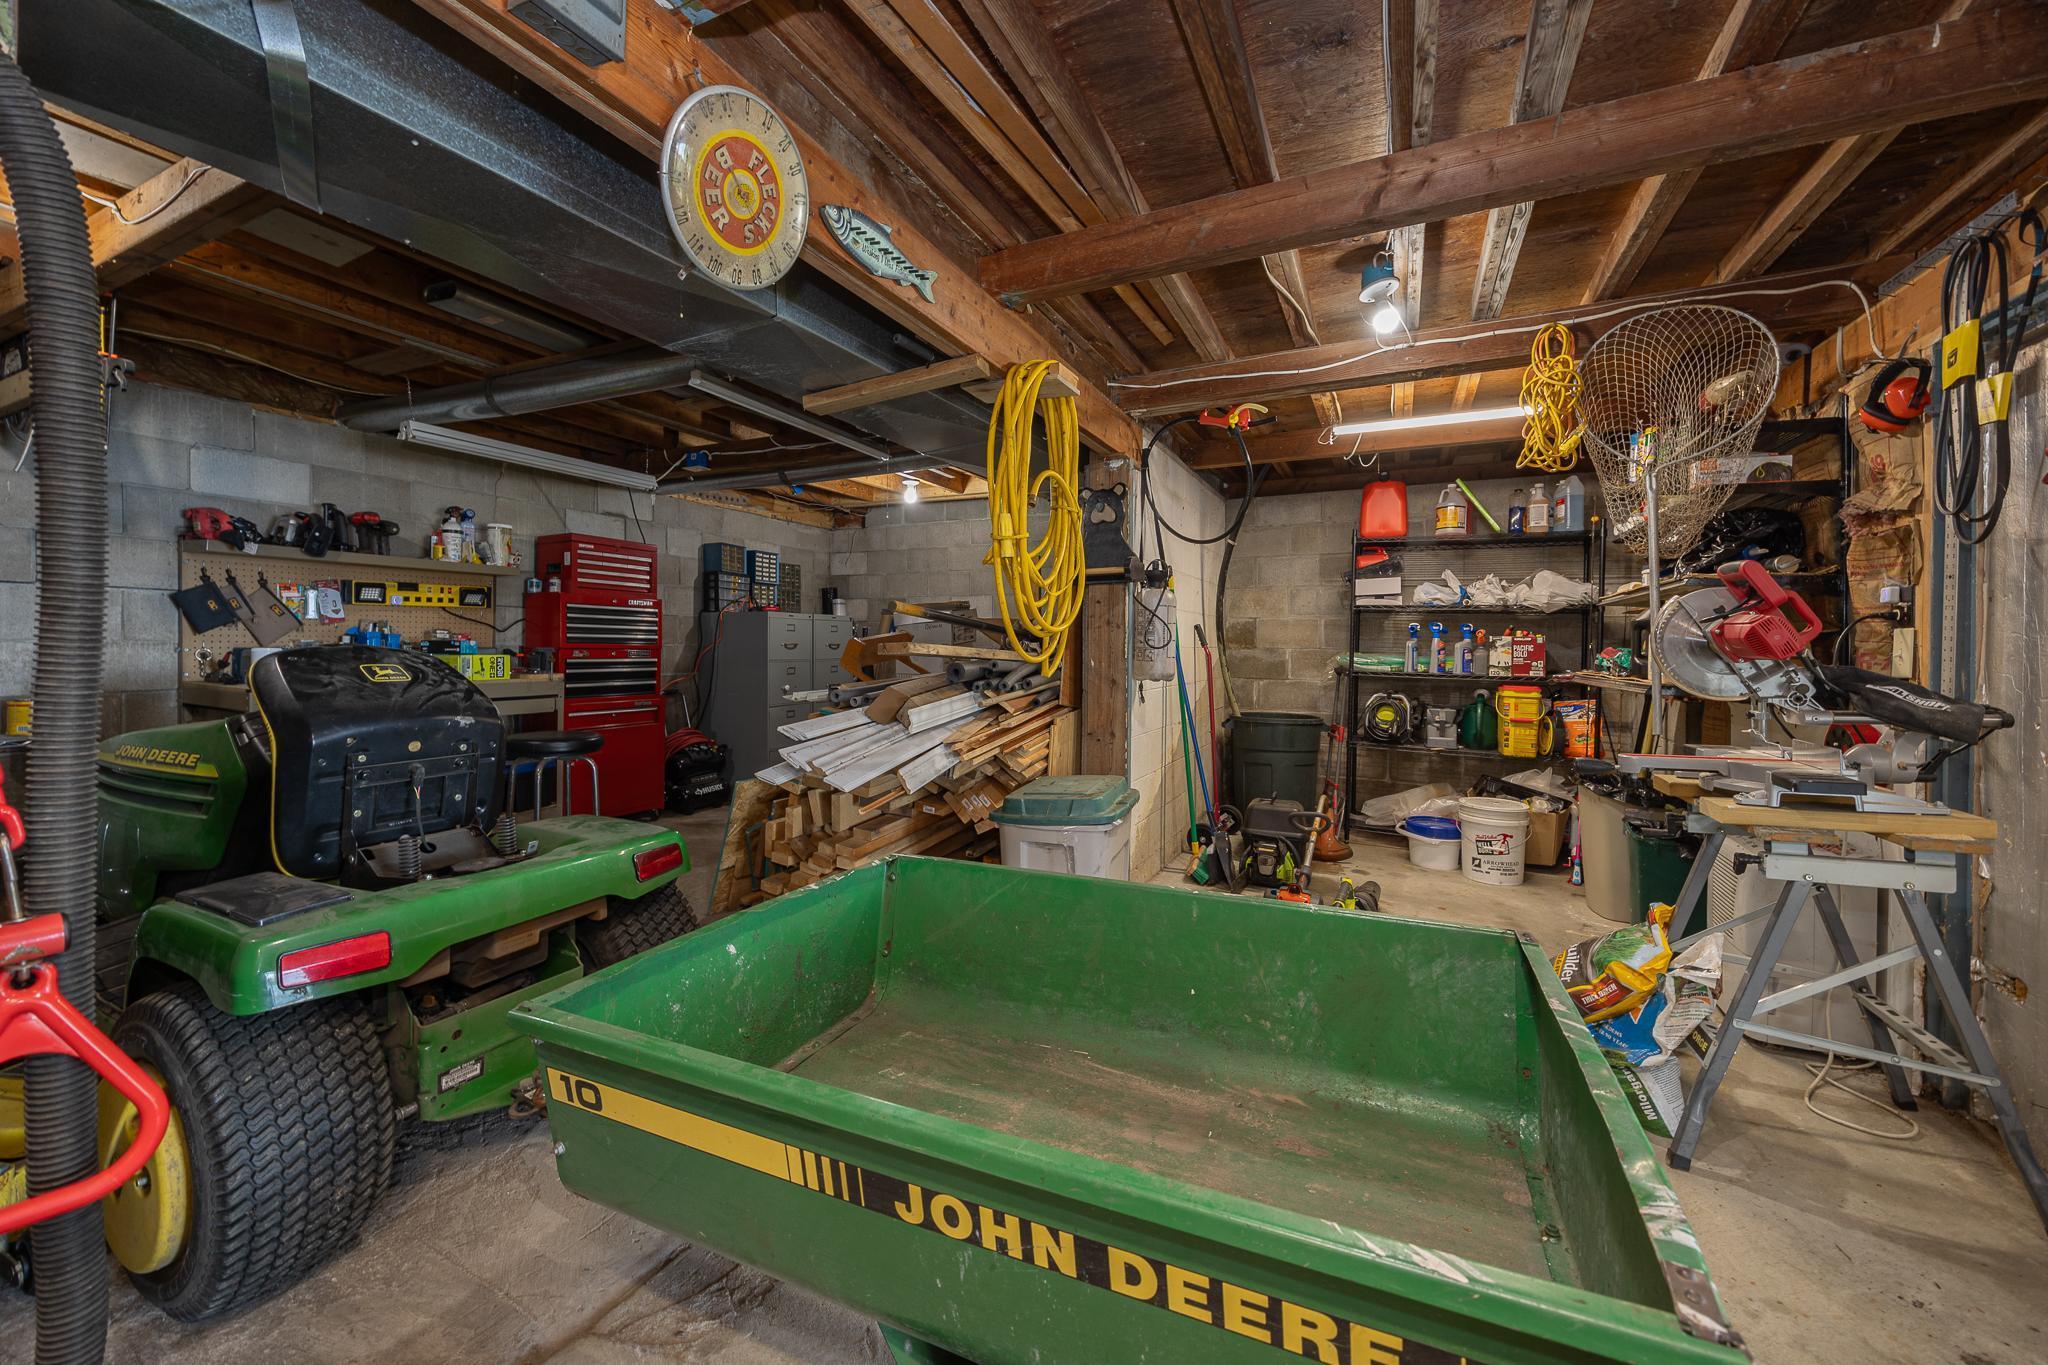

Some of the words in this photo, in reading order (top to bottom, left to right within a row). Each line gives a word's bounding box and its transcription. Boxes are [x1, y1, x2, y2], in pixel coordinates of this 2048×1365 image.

[762, 109, 774, 131] 10
[779, 134, 792, 153] 20
[790, 162, 801, 177] 30
[704, 144, 734, 232] BEER
[674, 205, 689, 226] 120
[707, 255, 723, 276] 100
[496, 657, 504, 678] RYOBI
[115, 744, 147, 758] JOHN
[148, 748, 201, 768] DEERE
[1483, 859, 1520, 867] ARROWHEAD
[560, 1074, 602, 1112] 10
[894, 1183, 1077, 1279] JOHN
[1107, 1245, 1403, 1365] DEERE
